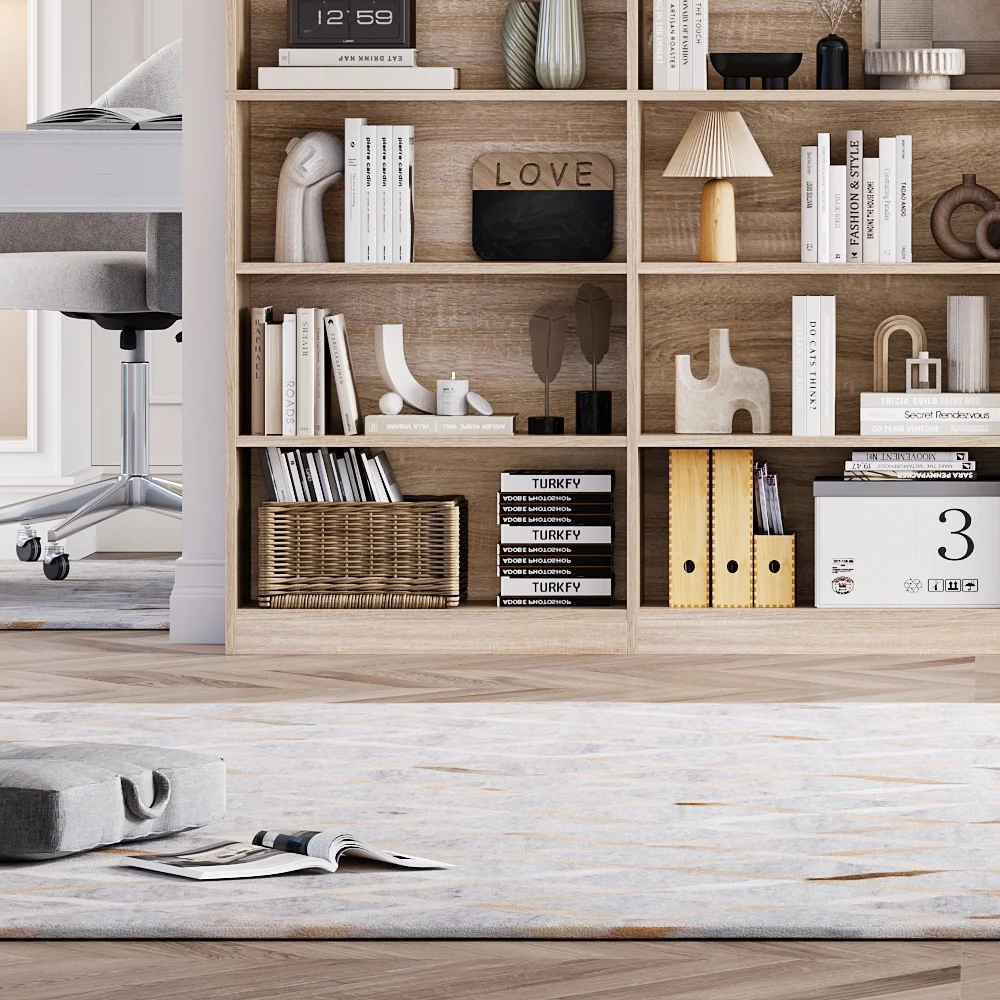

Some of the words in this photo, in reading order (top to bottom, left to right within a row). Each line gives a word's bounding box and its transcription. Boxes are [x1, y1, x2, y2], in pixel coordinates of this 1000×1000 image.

[850, 140, 859, 178] STYLE
[496, 162, 593, 187] LOVE
[851, 180, 859, 190] &
[850, 194, 859, 246] FASHION
[809, 321, 817, 336] DO
[809, 340, 817, 367] CATS
[286, 380, 295, 424] ROADS
[809, 372, 817, 411] THINK?
[904, 411, 934, 419] Secret
[935, 411, 990, 419] Rendezvous
[897, 471, 951, 479] PENNYPACKER
[952, 471, 974, 479] SARA
[937, 508, 975, 562] 3
